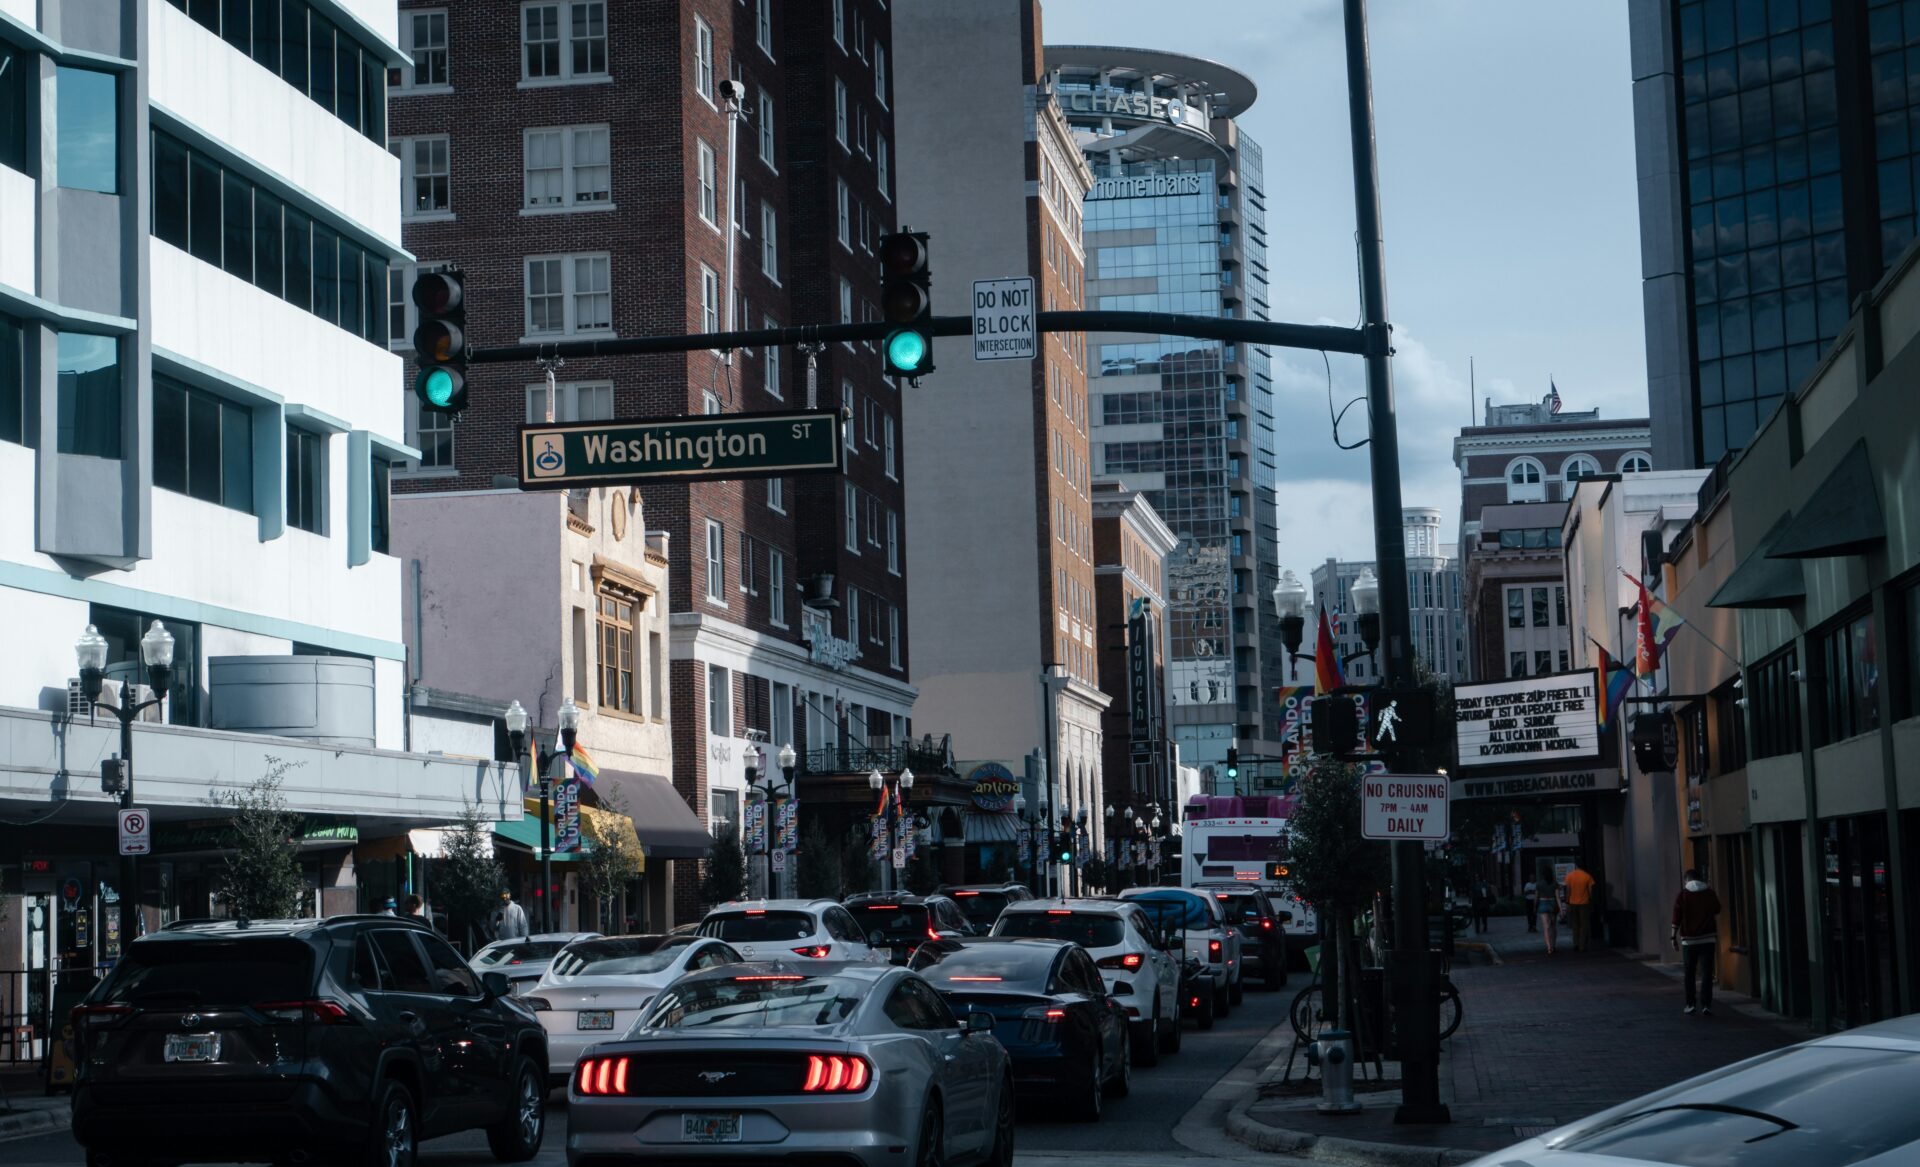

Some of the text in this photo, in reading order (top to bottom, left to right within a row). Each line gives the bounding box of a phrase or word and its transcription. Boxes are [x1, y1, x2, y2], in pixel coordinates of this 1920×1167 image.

[1071, 90, 1164, 117] CHASE
[1095, 170, 1200, 199] home loans
[977, 288, 1029, 309] DO NOT
[977, 314, 1031, 335] BLOCK
[977, 337, 1032, 353] INTERSECTION
[583, 423, 812, 468] Washington ST
[1456, 696, 1482, 710] FRIDAY
[1484, 692, 1525, 707] EVERYONE
[1456, 707, 1495, 722] SATURDAY
[1562, 699, 1585, 712] FREE
[1488, 714, 1556, 731] BARRIO SUNDAY
[1285, 696, 1300, 778] ORLANDO
[1488, 730, 1504, 743] ALL
[1505, 729, 1512, 741] U
[1533, 726, 1560, 740] DRINK
[1501, 740, 1542, 755] UNKNOWN
[1545, 737, 1580, 751] MORTAL
[1366, 783, 1445, 799] NO CRUISING
[1463, 773, 1596, 797] WWW.THEBEACHAM.COM
[556, 784, 566, 837] ORLANDO
[566, 783, 579, 837] UNITED
[1380, 802, 1398, 813] 7PM
[1409, 803, 1429, 814] 4AM
[753, 804, 763, 845] UNITED
[779, 803, 787, 845] ORLANDO
[787, 803, 796, 845] UNITED
[879, 817, 888, 851] UNITED
[905, 817, 914, 851] UNITED
[1387, 817, 1425, 833] DAILY
[1274, 865, 1289, 876] 15
